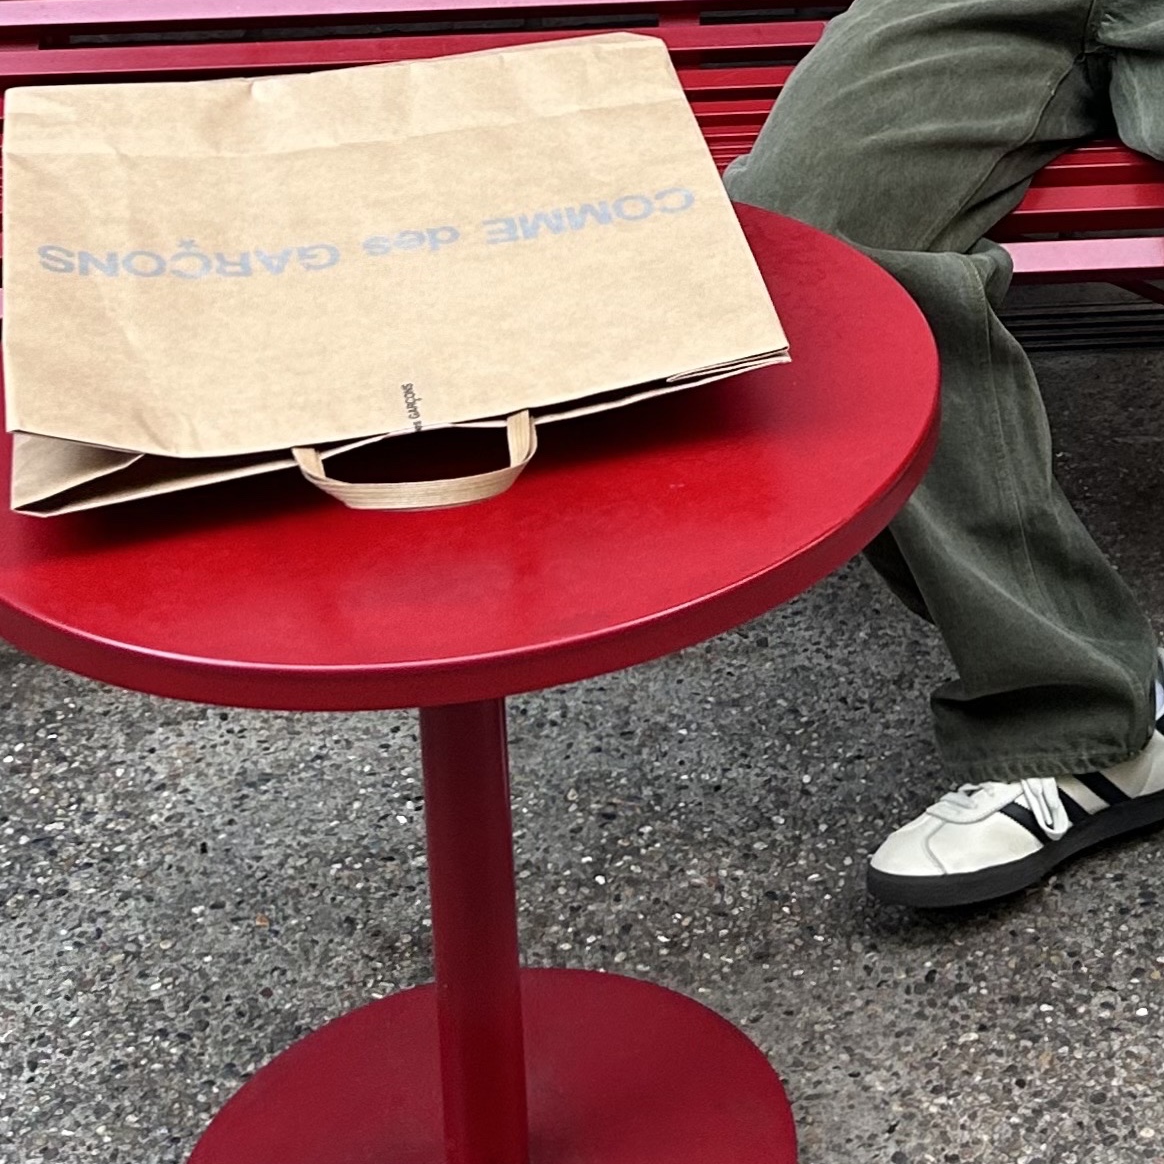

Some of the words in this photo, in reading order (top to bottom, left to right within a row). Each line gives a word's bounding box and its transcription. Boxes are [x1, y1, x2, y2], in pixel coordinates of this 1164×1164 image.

[481, 187, 695, 245] COMME
[37, 238, 341, 279] GARÇONS
[362, 225, 461, 257] des
